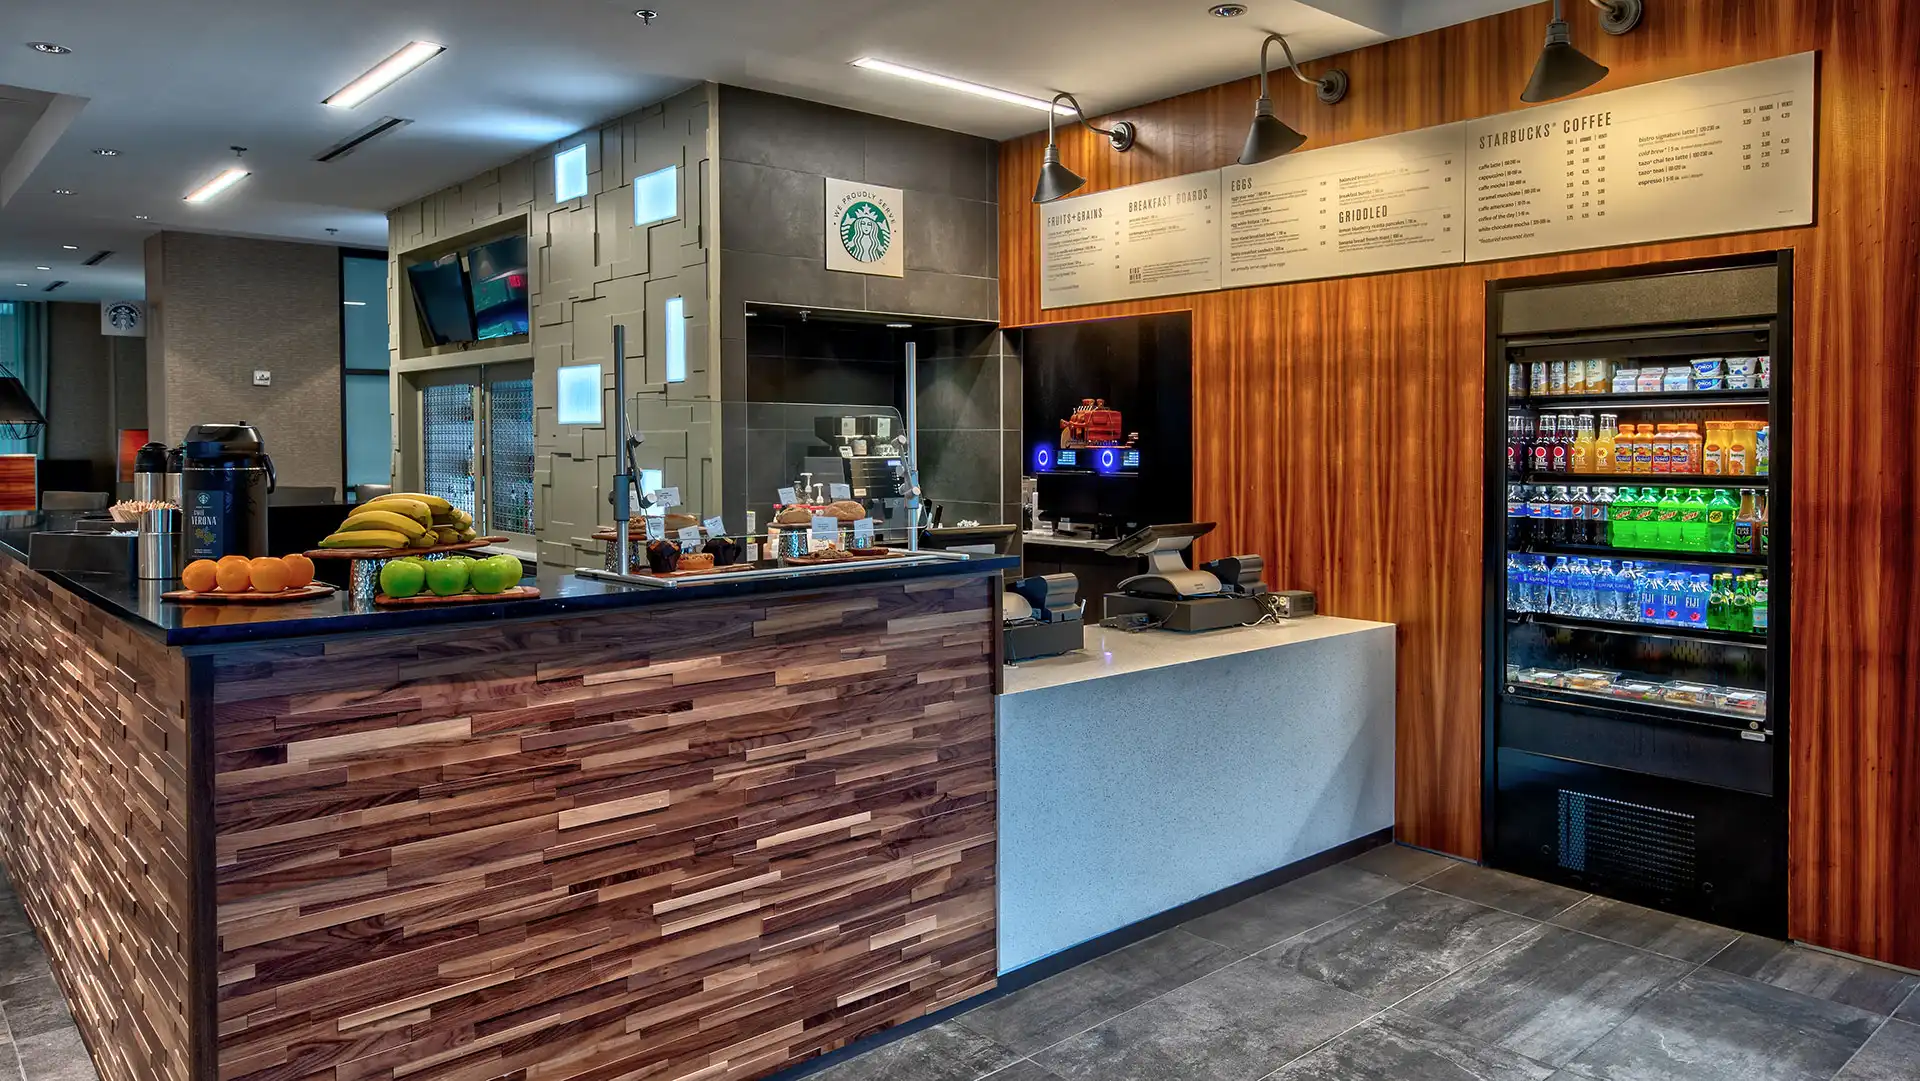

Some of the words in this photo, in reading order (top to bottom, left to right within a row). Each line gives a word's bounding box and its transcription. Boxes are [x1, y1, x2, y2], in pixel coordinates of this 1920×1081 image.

[1564, 112, 1611, 133] COFFEE
[1656, 132, 1680, 140] signature
[1232, 178, 1252, 191] EGGS
[1638, 178, 1662, 186] espresso
[1128, 195, 1171, 212] BREAKFAST
[1176, 188, 1208, 204] BOARDS
[834, 205, 842, 218] WE
[842, 191, 876, 204] PROUDLY
[878, 199, 896, 224] SERVE
[1047, 208, 1103, 227] FRUITS+GRAINS
[1339, 205, 1388, 223] GRIDDLED
[191, 516, 216, 525] VERONA
[1642, 593, 1654, 604] FIJI
[1664, 594, 1677, 605] FIJI
[1686, 597, 1699, 608] FIJI
